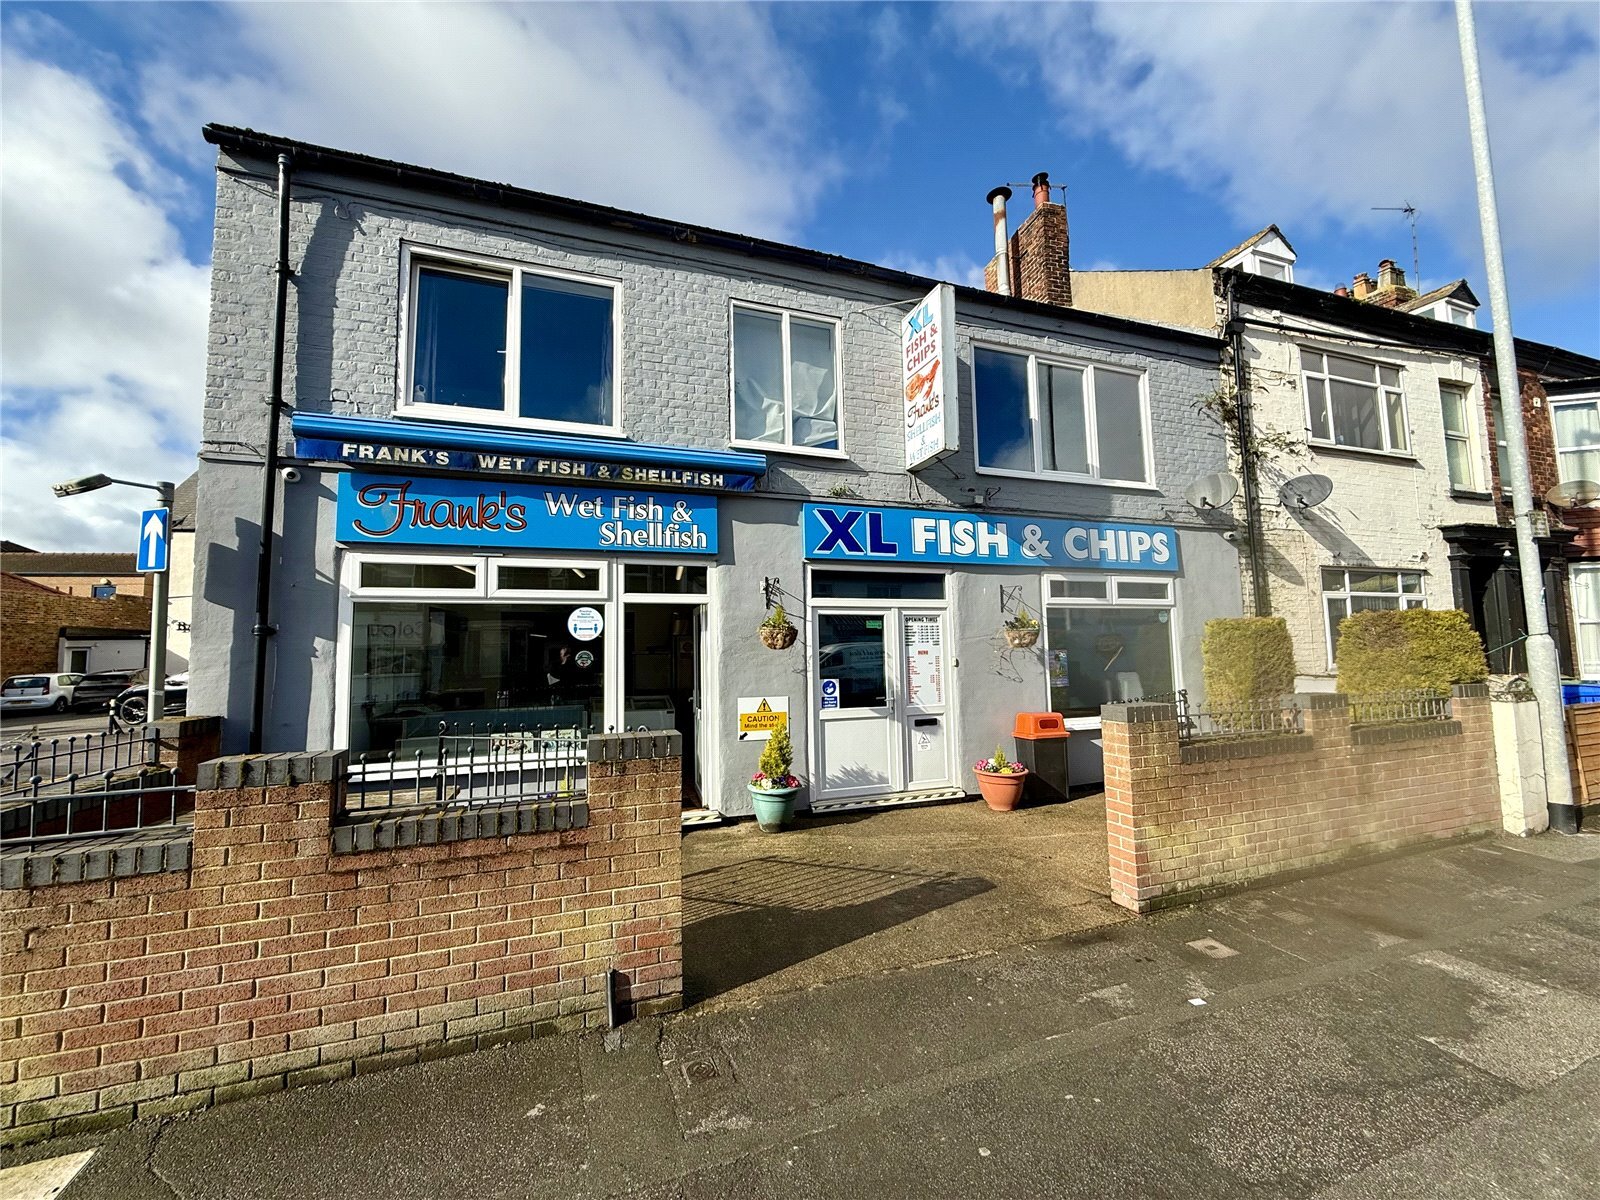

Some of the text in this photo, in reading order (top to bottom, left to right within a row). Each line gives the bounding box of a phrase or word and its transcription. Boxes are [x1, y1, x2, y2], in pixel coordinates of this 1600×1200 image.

[906, 323, 938, 359] FISH &
[908, 302, 934, 342] XL
[907, 339, 936, 372] CHIPS
[342, 443, 724, 487] FRANK'S WET FISH & SHELLFISH
[352, 480, 693, 538] Frank's Wet Fish &
[599, 520, 707, 549] Shellfish
[813, 508, 1170, 565] XL FISH & CHIPS
